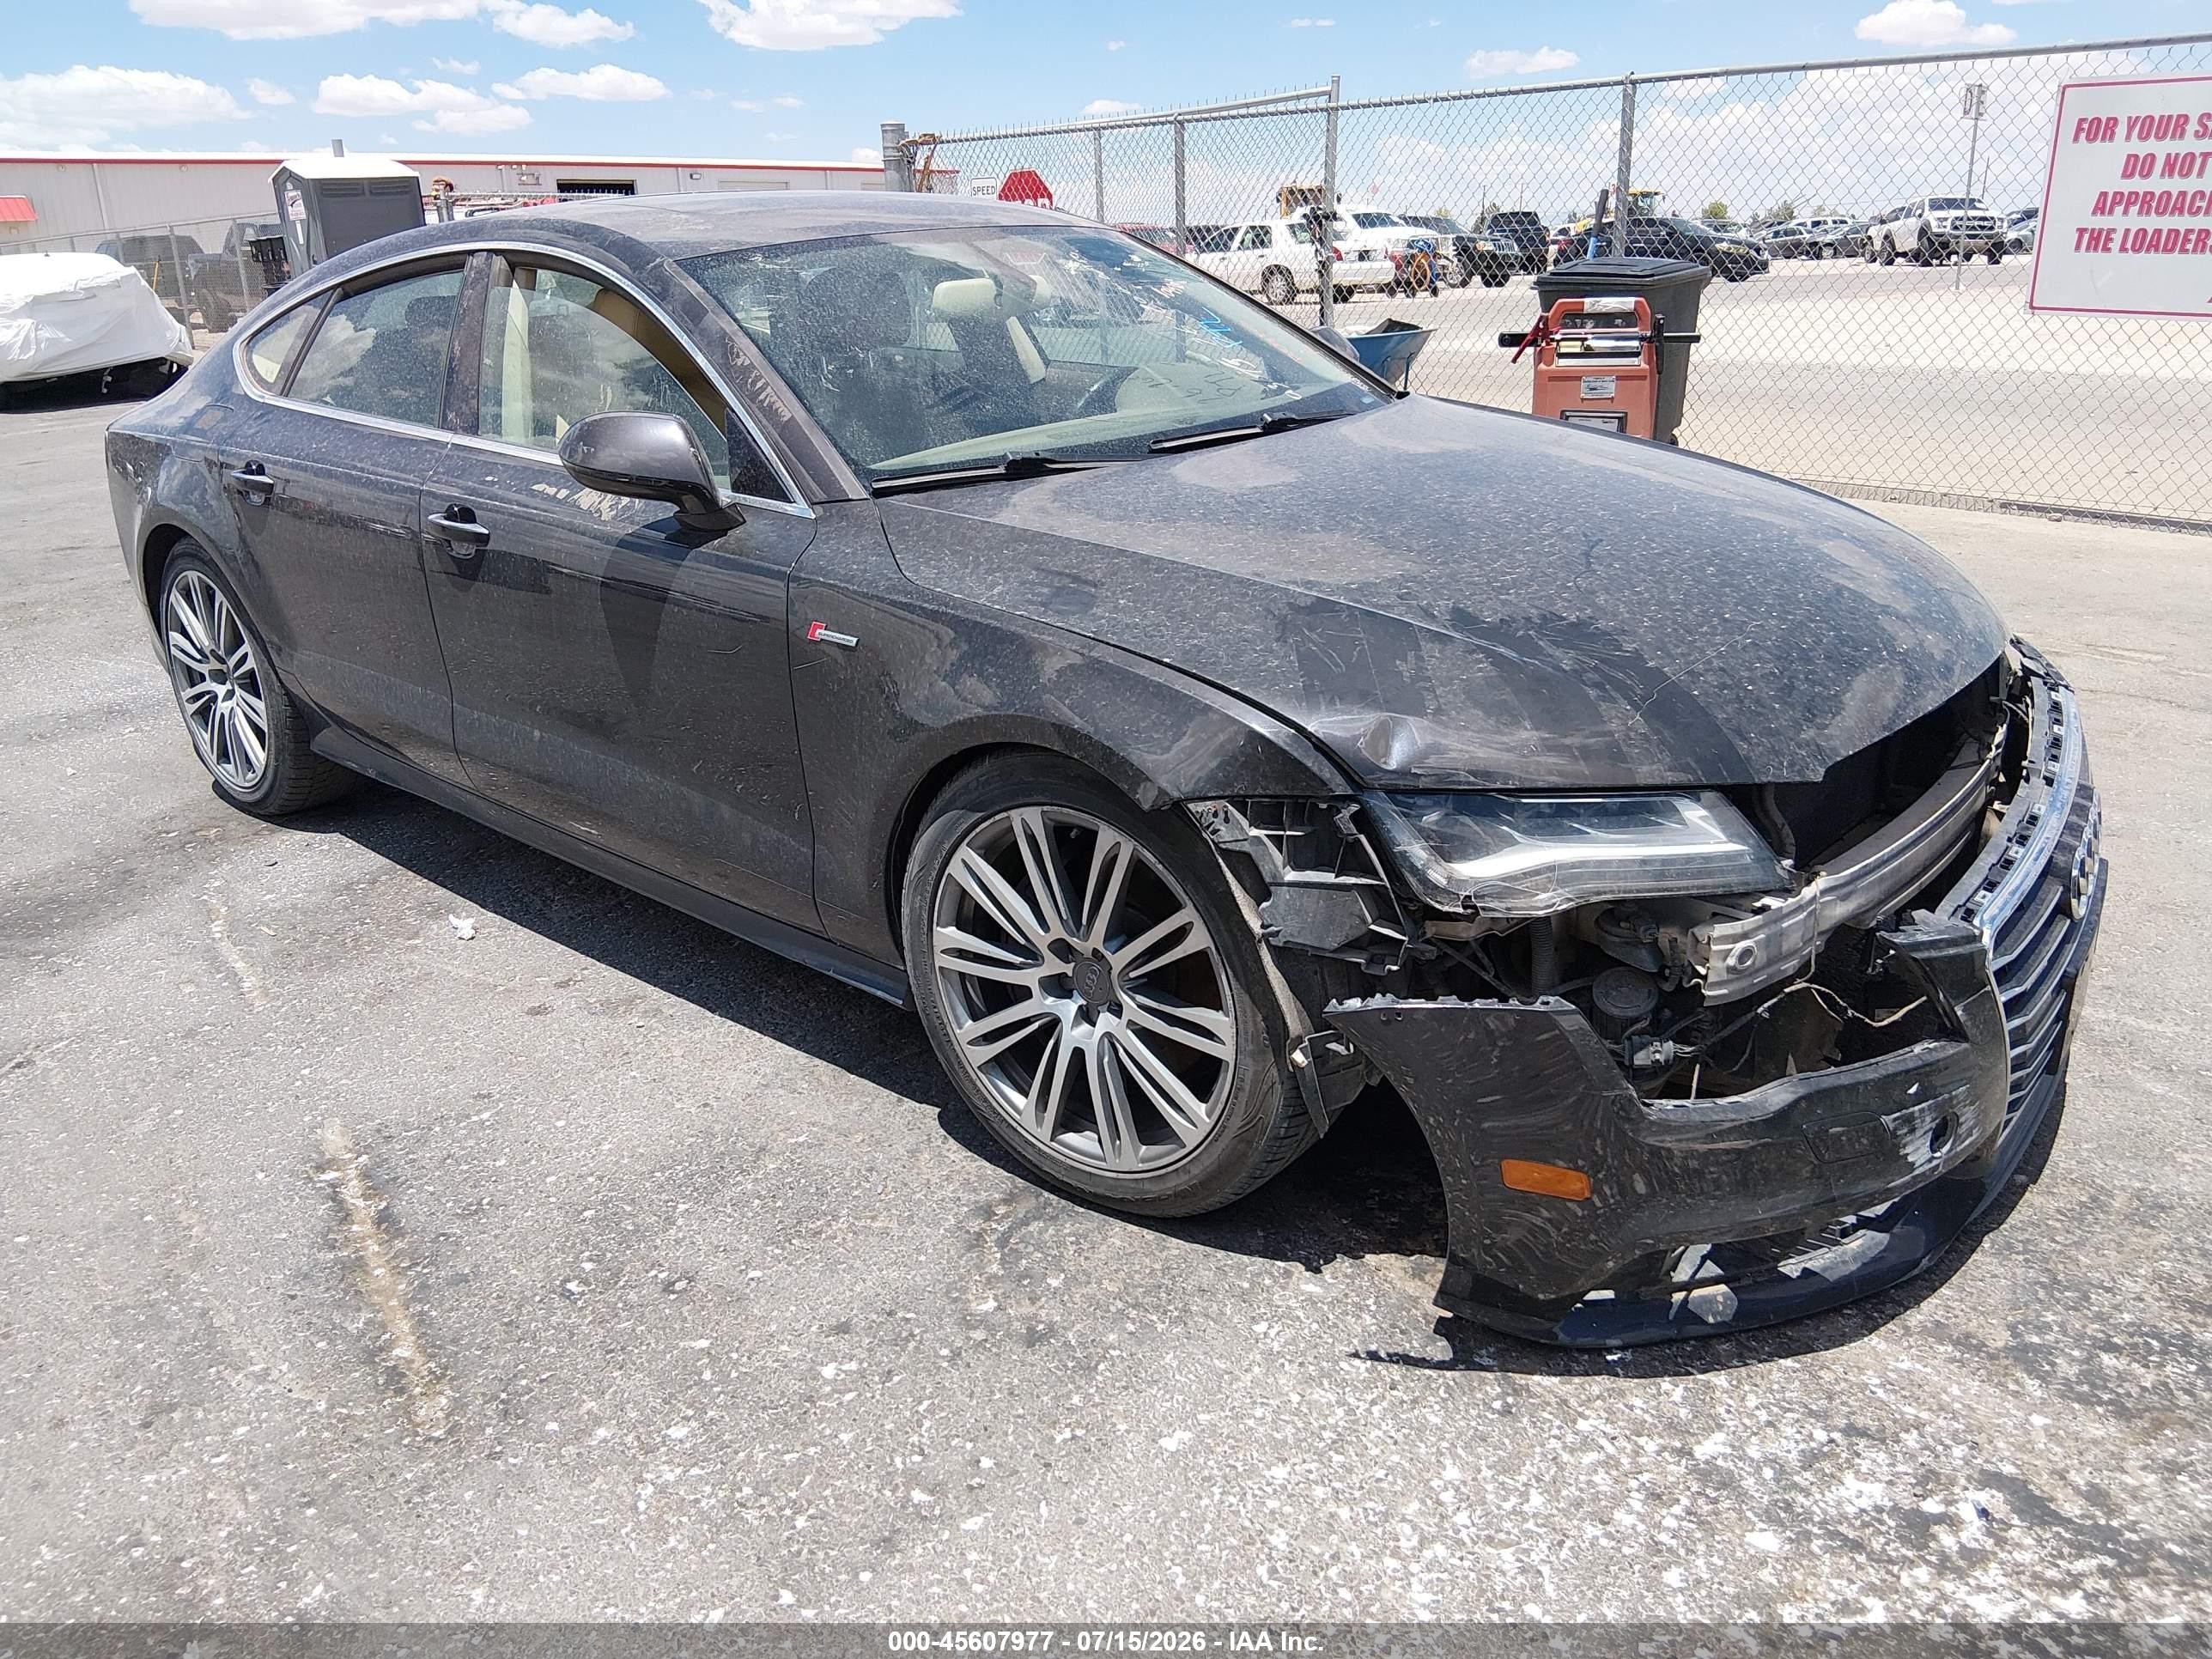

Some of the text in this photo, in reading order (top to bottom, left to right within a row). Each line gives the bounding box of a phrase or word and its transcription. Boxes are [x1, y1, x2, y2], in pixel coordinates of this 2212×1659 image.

[2072, 112, 2212, 143] FOR YOUR S
[2120, 151, 2212, 179] DO NOT
[972, 186, 996, 196] SPEED
[2074, 227, 2212, 255] THE LOADER
